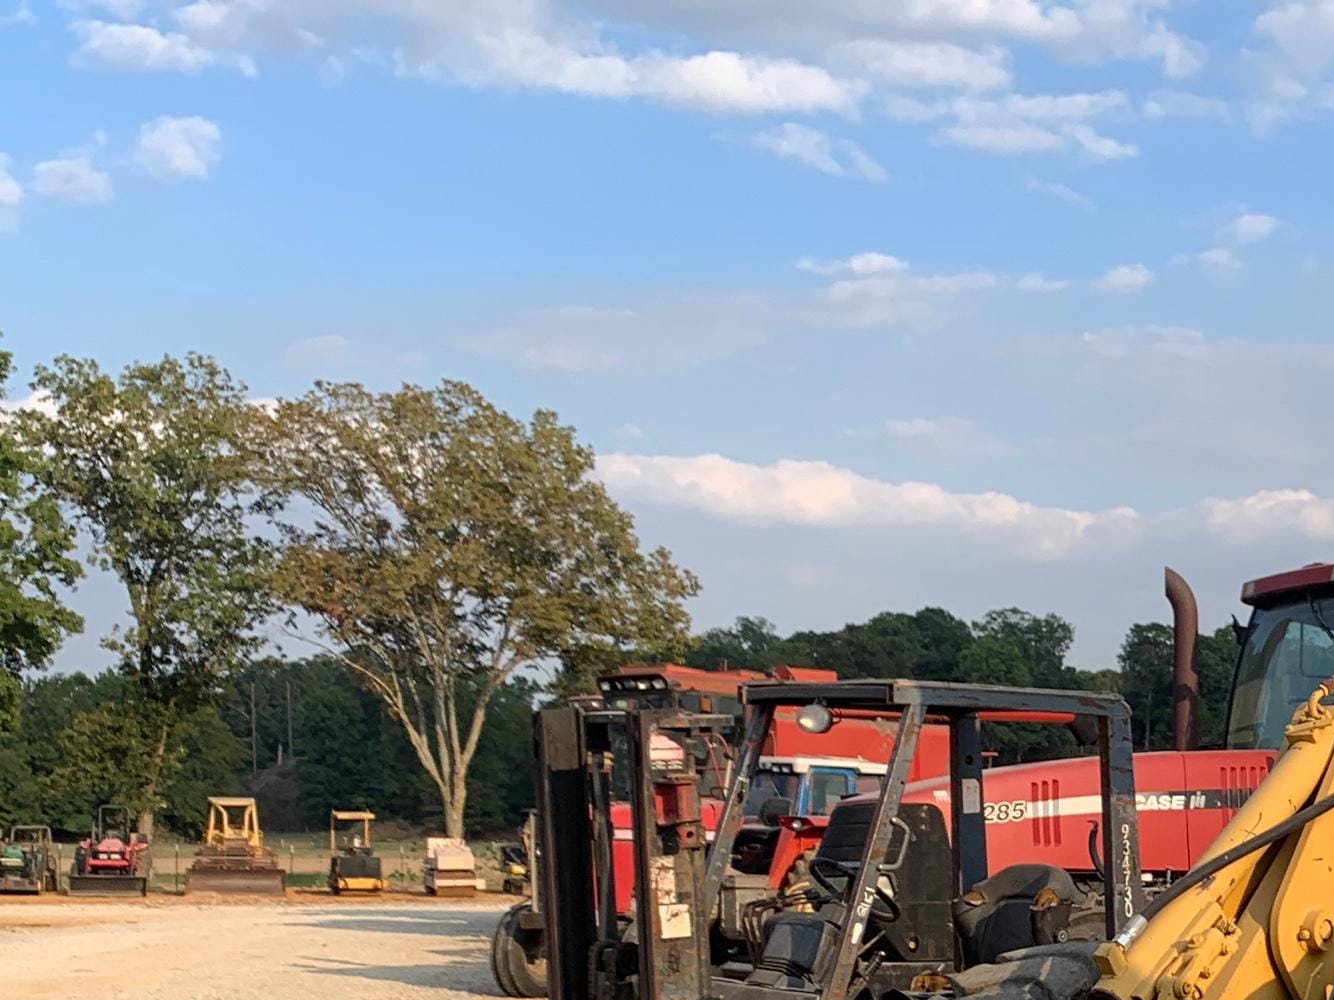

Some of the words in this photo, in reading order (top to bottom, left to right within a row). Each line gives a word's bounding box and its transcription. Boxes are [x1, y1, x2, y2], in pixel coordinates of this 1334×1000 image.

[984, 802, 1025, 821] 285
[1135, 794, 1186, 811] CASE
[1121, 823, 1133, 918] 934730
